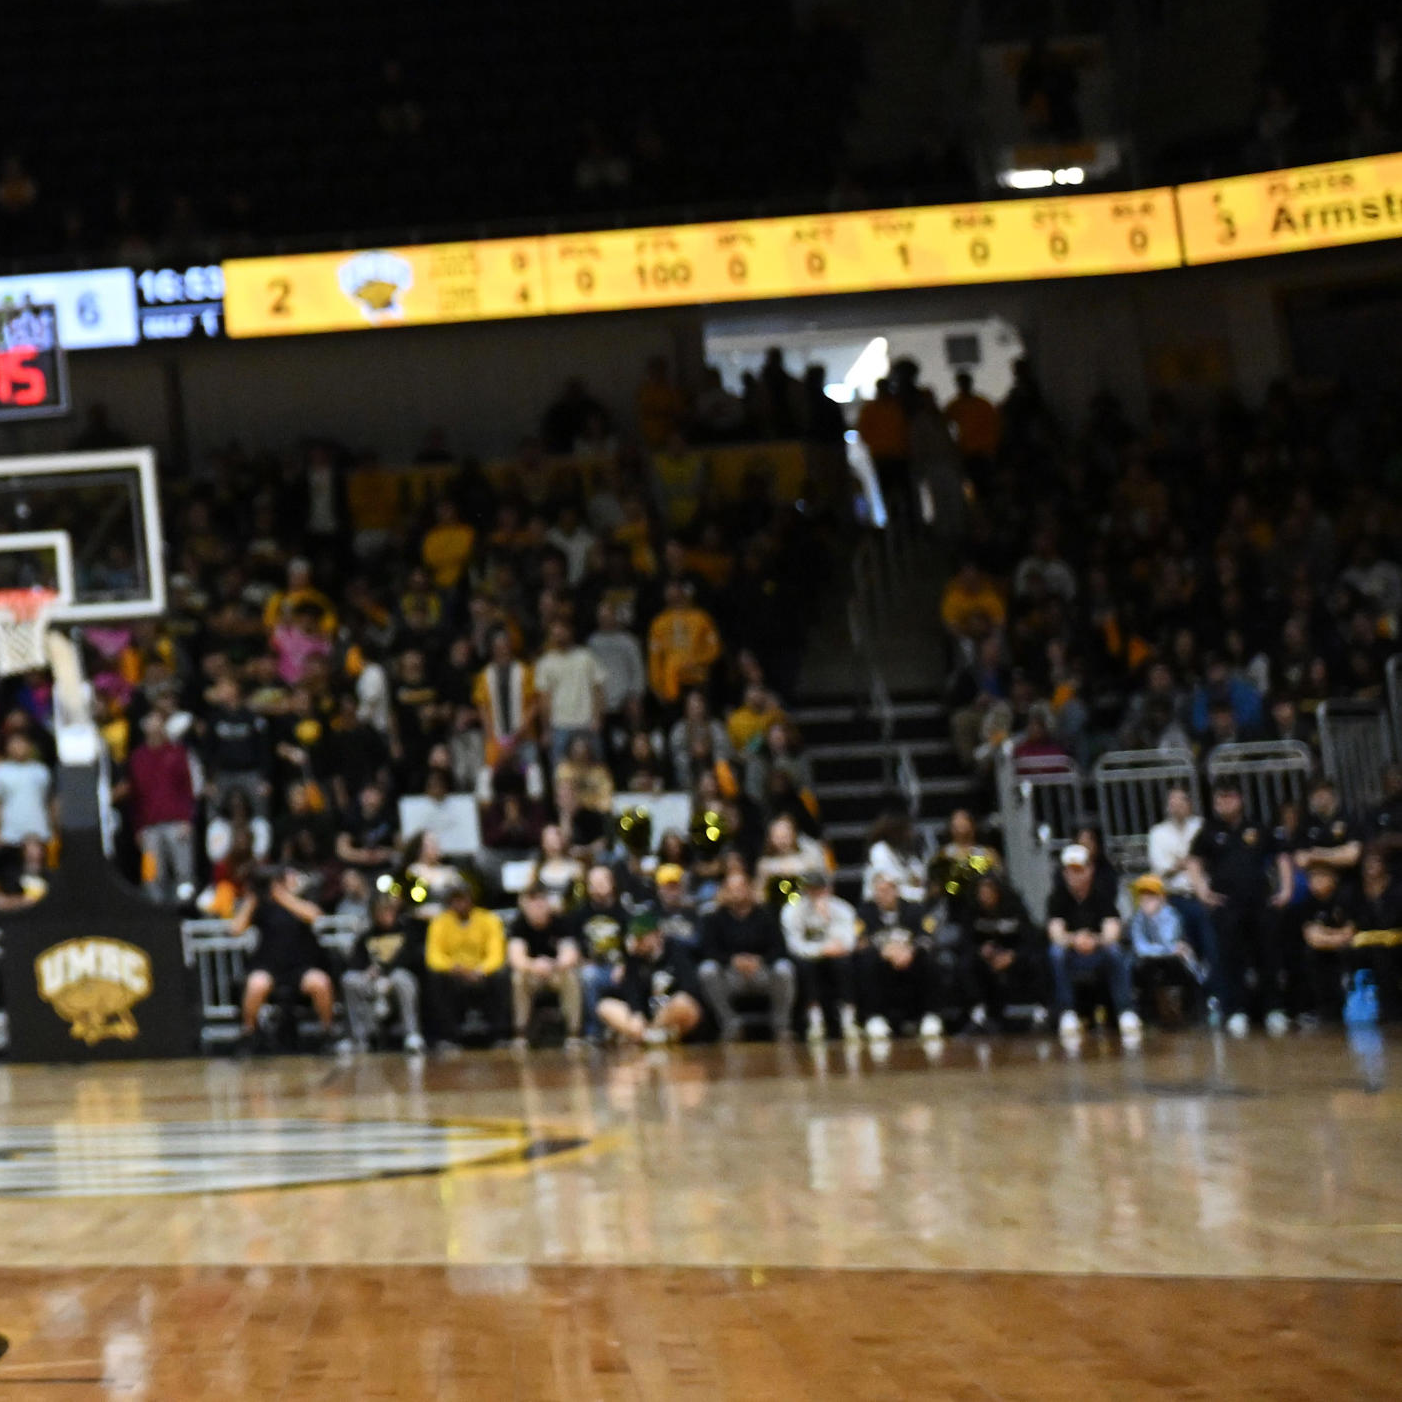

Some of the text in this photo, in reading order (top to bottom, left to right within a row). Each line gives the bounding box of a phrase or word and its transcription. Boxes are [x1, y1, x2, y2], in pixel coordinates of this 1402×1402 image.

[1270, 192, 1402, 236] Armst
[635, 258, 693, 289] 100
[727, 253, 748, 284] 0
[806, 248, 826, 278] 0
[970, 236, 991, 266] 0
[1048, 230, 1069, 259] 0
[1128, 225, 1149, 256] 0
[76, 289, 102, 331] 6
[266, 278, 294, 316] 2
[38, 938, 151, 996] UMBC
